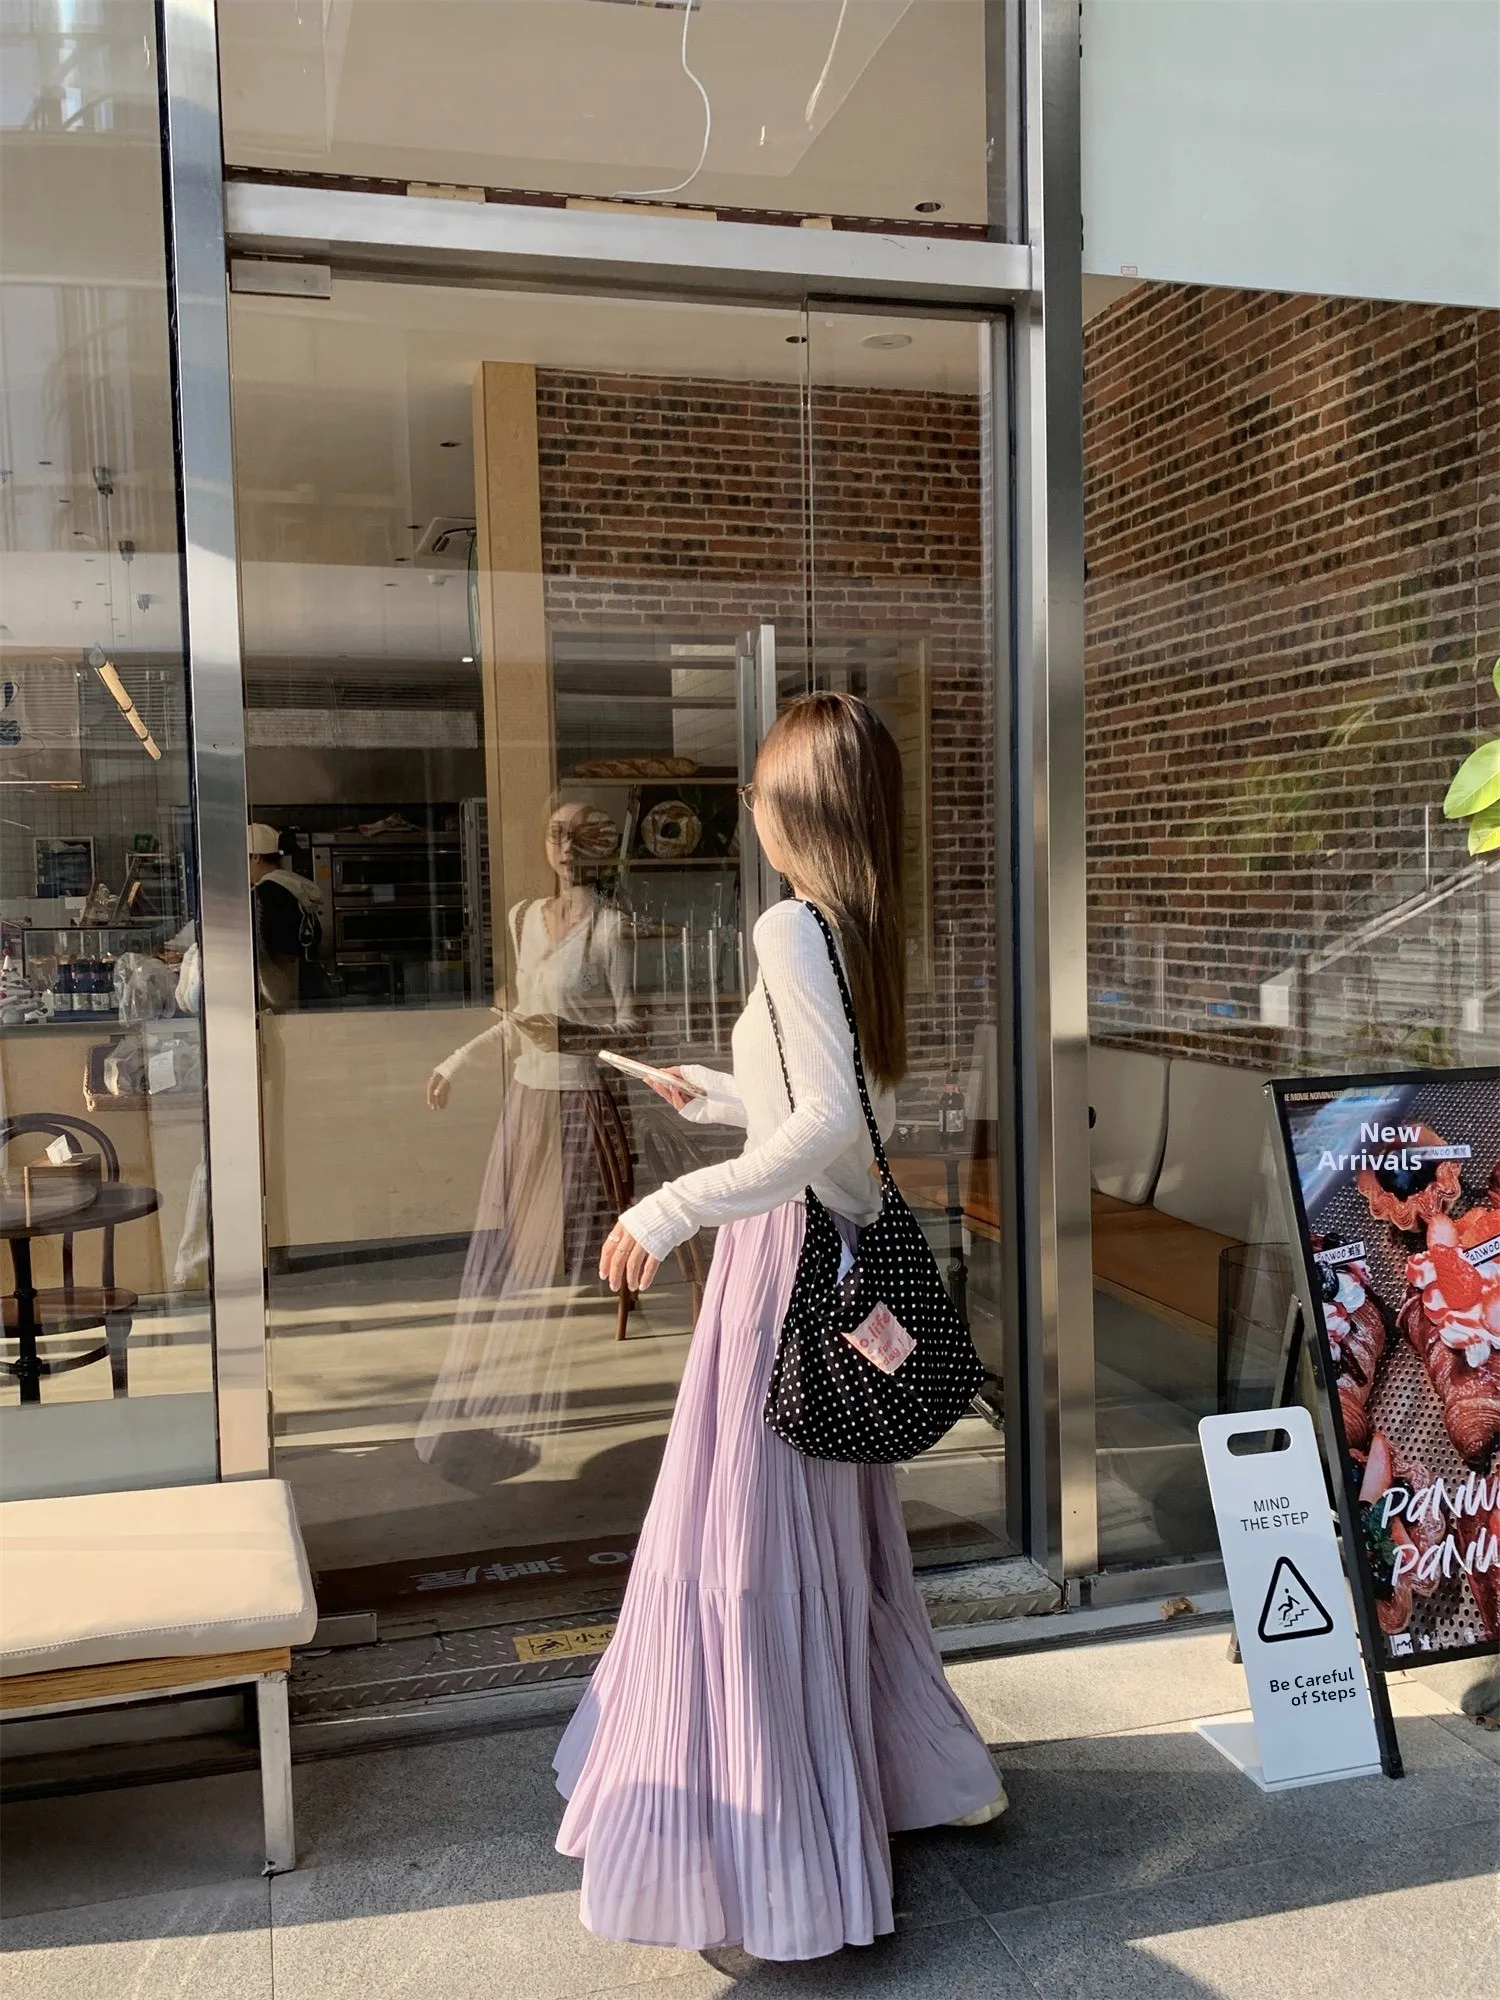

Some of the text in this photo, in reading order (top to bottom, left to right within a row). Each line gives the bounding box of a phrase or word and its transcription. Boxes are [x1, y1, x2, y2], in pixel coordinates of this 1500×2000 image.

[1290, 1092, 1310, 1101] MOVIE
[1360, 1122, 1421, 1143] New
[1317, 1148, 1422, 1171] Arrivals
[1253, 1496, 1290, 1512] MIND
[1240, 1511, 1309, 1532] THE STEP
[1269, 1666, 1355, 1693] Be Careful
[1291, 1687, 1356, 1706] of Steps
